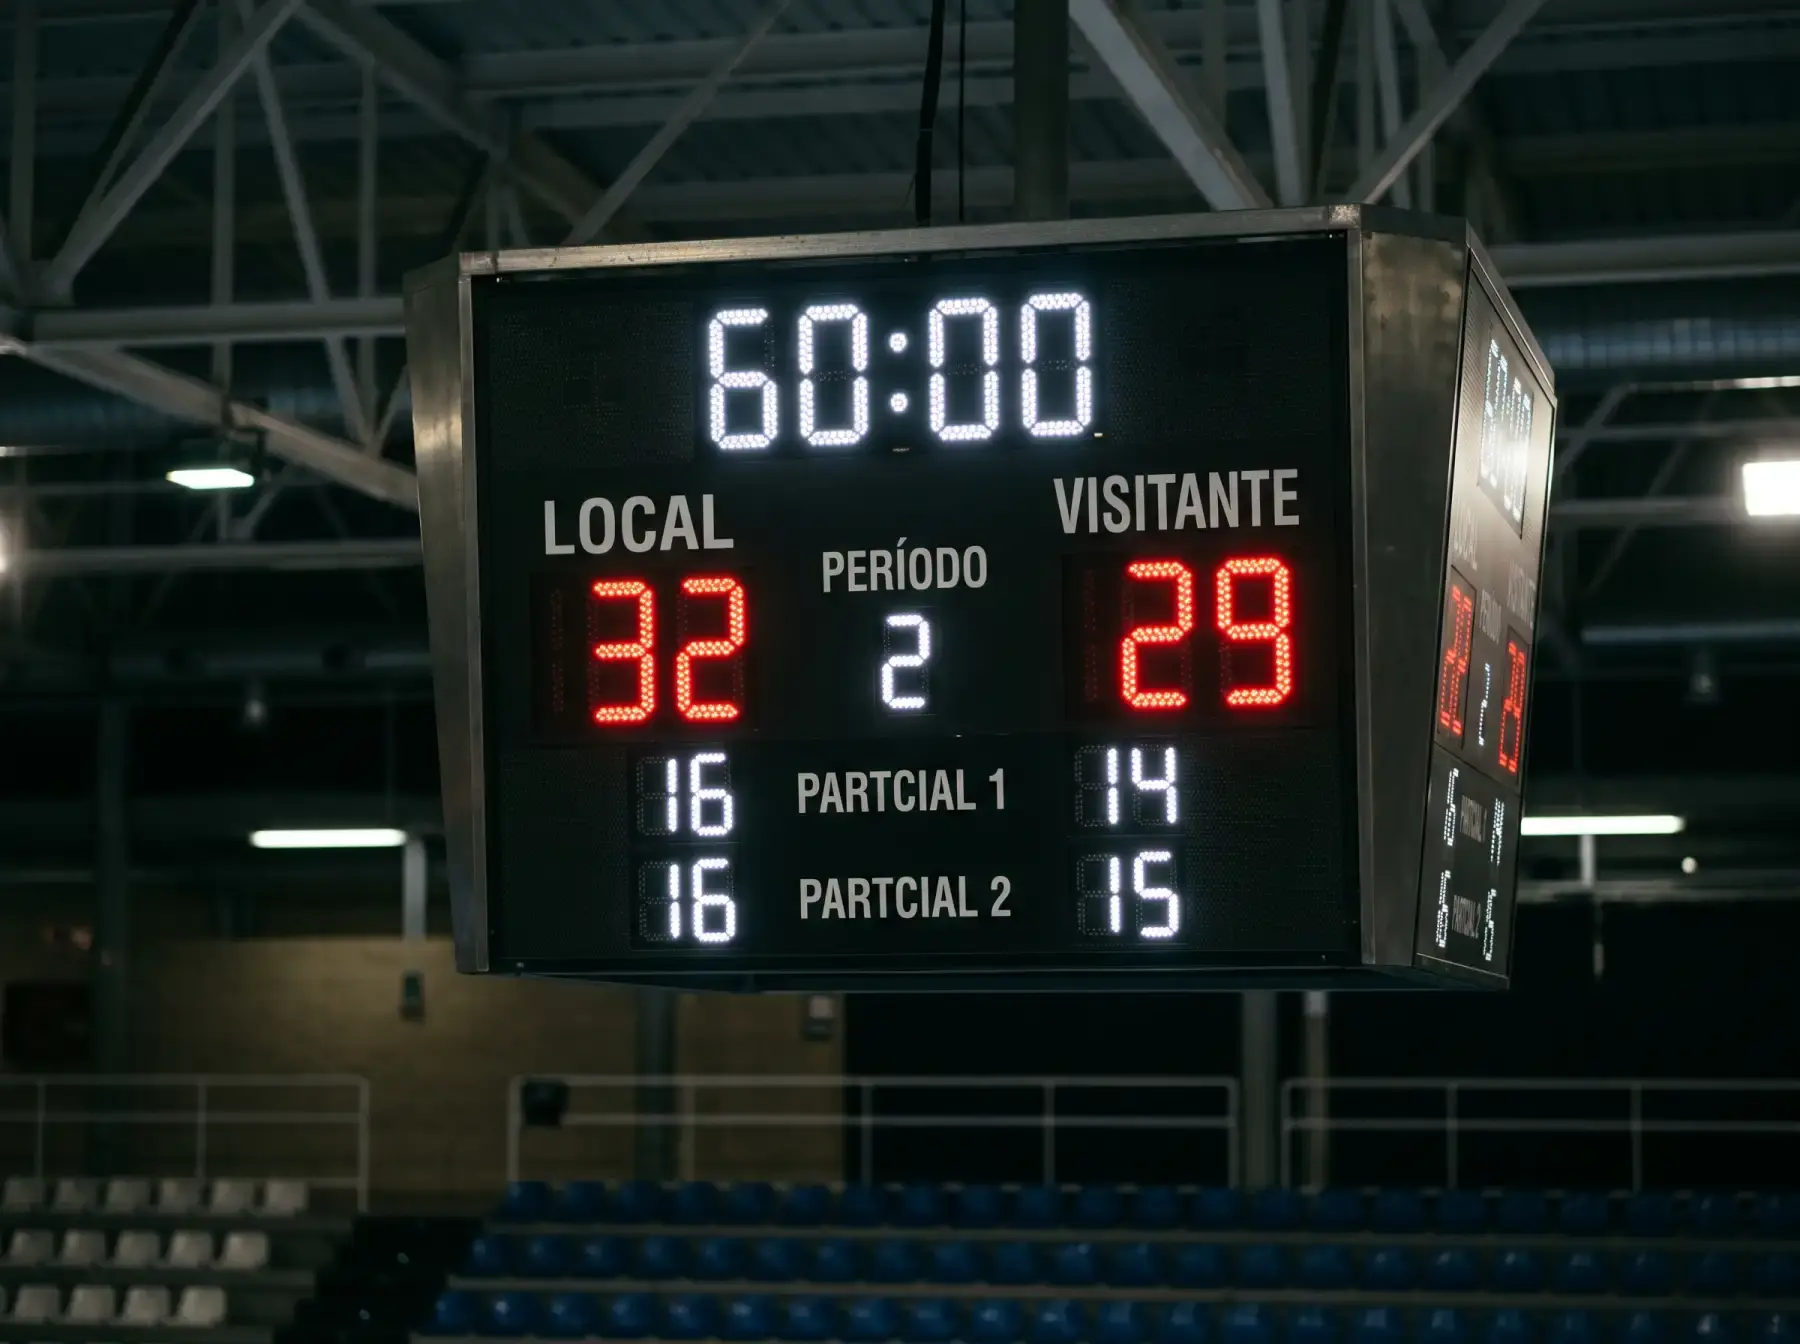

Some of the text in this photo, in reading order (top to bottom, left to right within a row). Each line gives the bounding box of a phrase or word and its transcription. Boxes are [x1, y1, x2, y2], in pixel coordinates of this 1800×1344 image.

[707, 290, 1093, 451] 60:00
[545, 494, 734, 555] LOCAL
[1054, 469, 1299, 534] VISITANTE
[822, 537, 987, 593] PERÍODO
[592, 575, 748, 725] 32
[881, 613, 932, 710] 2
[1118, 555, 1295, 711] 29
[667, 752, 735, 837] 16
[798, 769, 1005, 814] PARTCIAL 1
[1105, 747, 1178, 825] 14
[668, 858, 737, 944] 16
[799, 876, 1012, 920] PARTCIAL 2
[1107, 850, 1181, 940] 15
